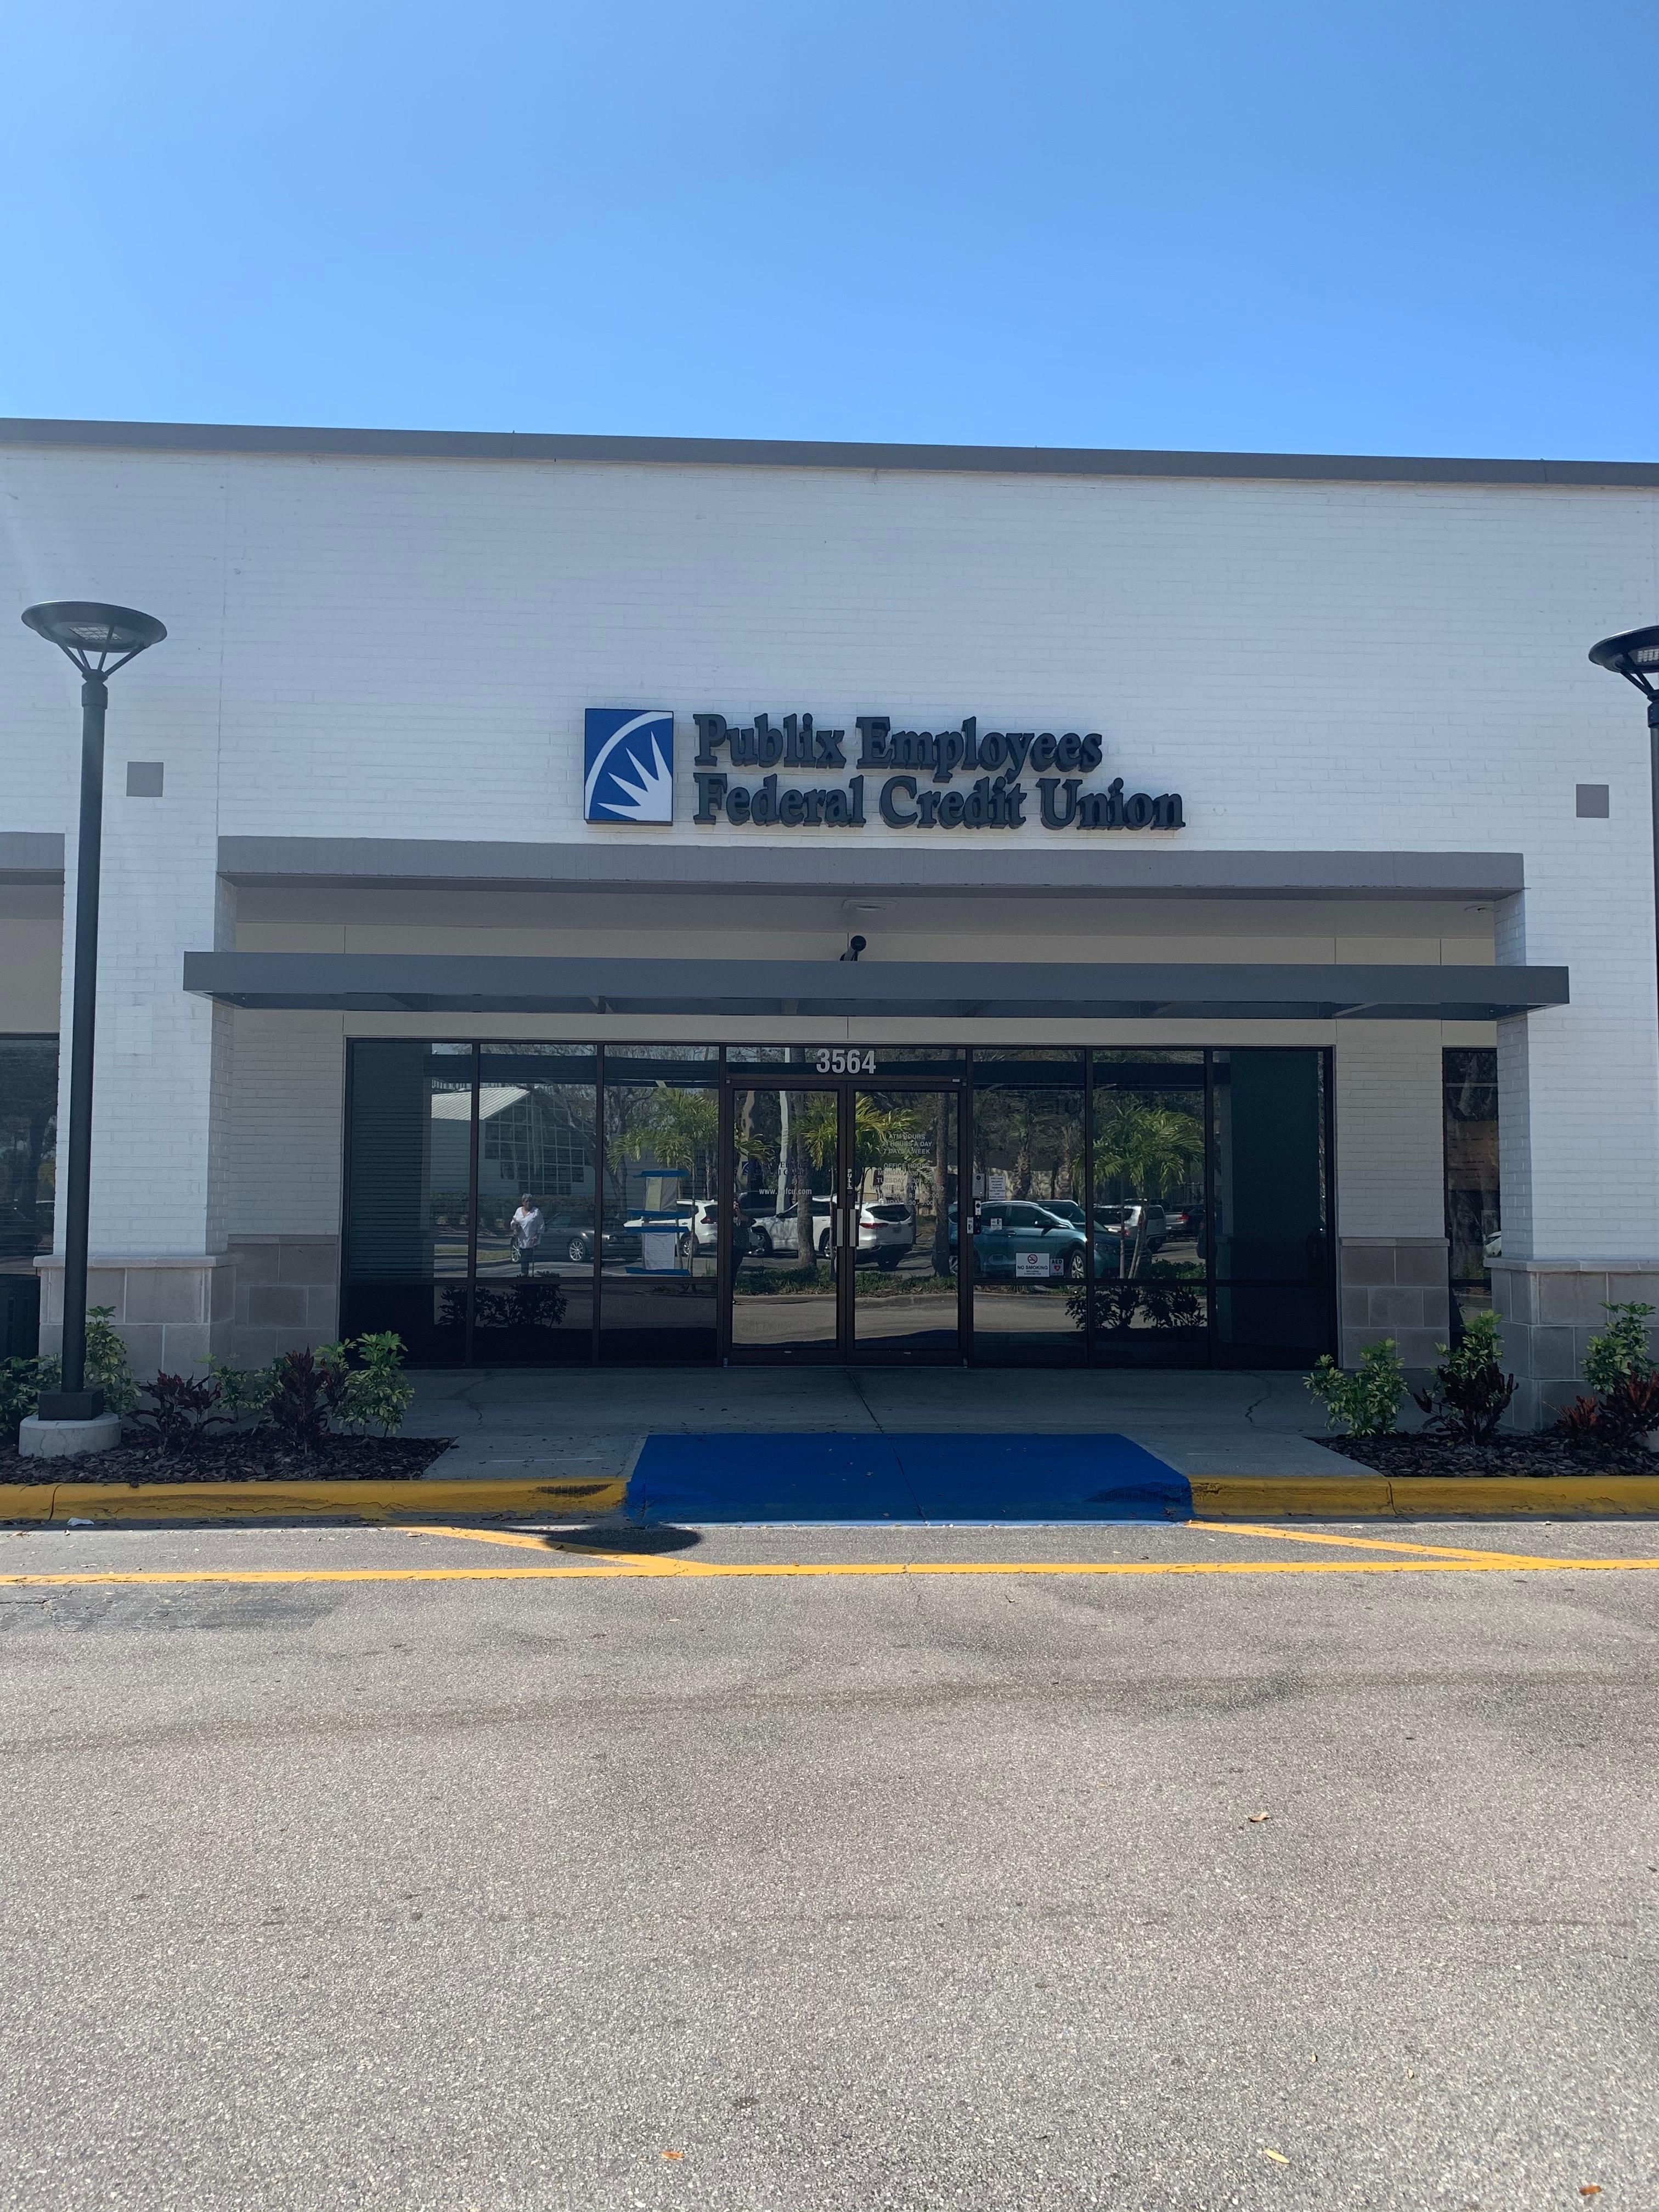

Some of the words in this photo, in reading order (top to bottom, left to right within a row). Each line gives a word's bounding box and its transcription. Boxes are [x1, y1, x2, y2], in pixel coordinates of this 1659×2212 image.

[693, 713, 847, 769] Publix
[856, 716, 1103, 783] Employees
[693, 772, 866, 827] Federal
[879, 776, 1027, 829] Credit
[1039, 777, 1186, 831] Union
[816, 1048, 876, 1074] 3564
